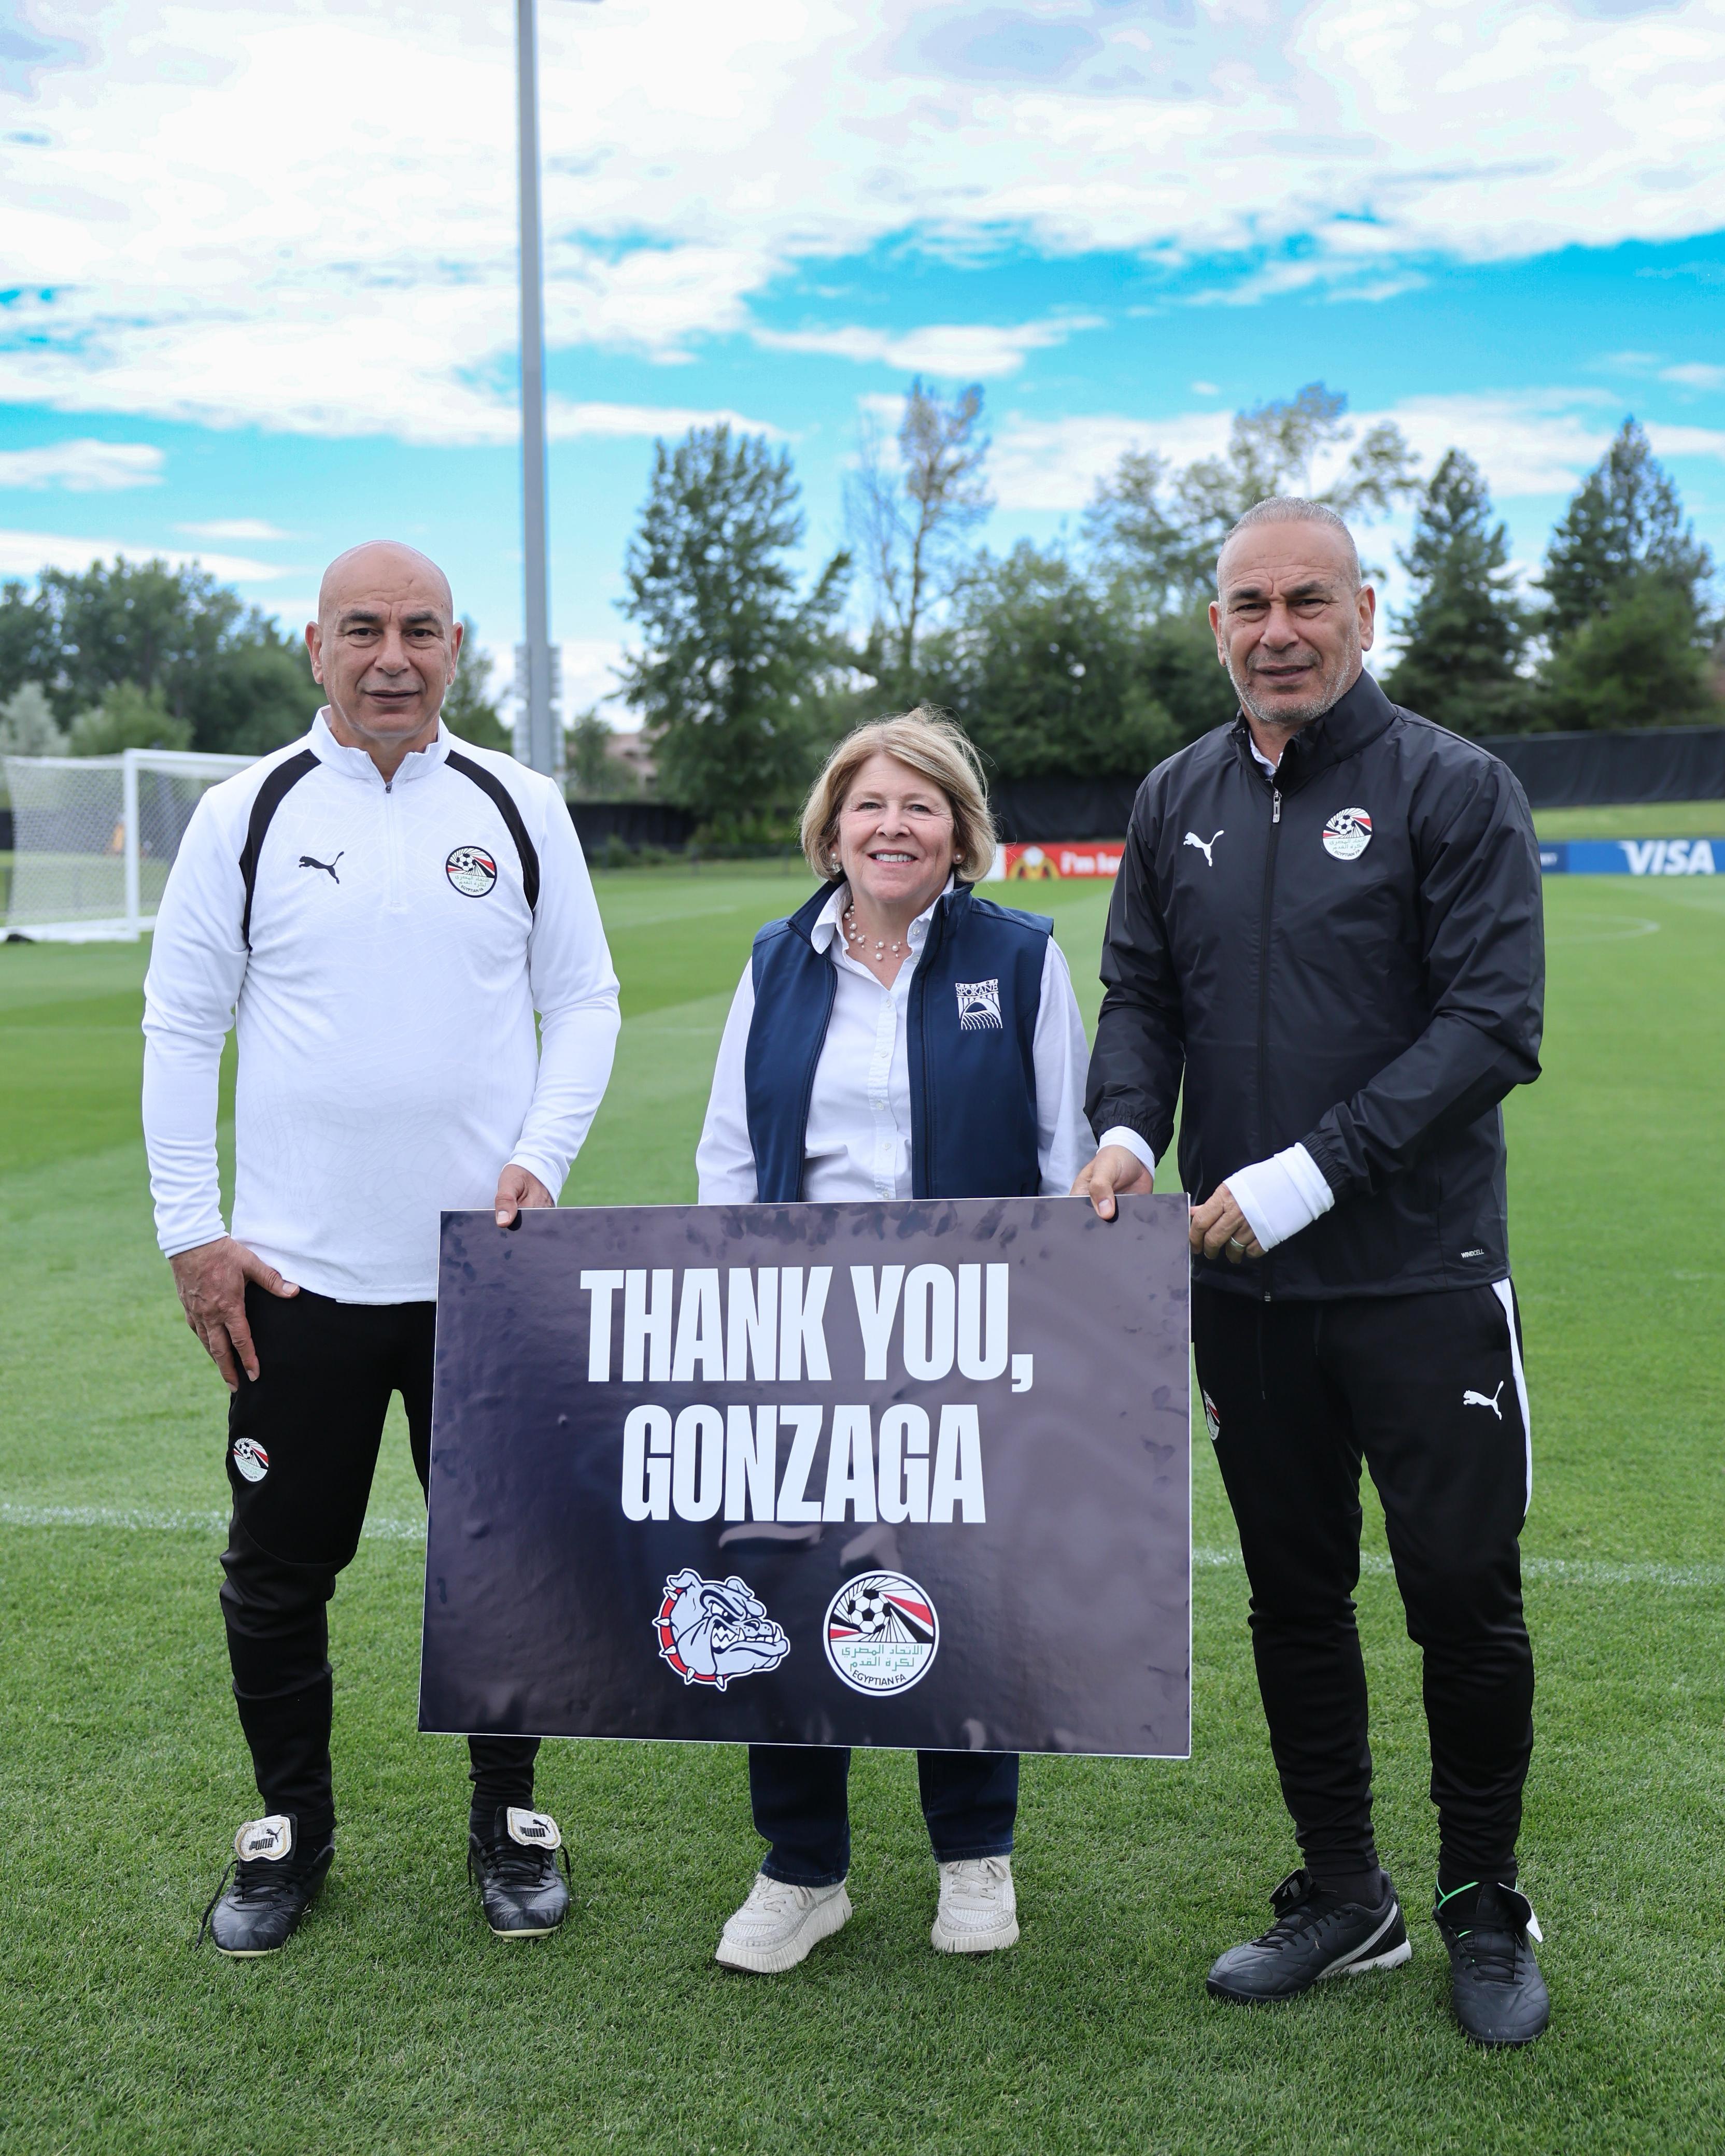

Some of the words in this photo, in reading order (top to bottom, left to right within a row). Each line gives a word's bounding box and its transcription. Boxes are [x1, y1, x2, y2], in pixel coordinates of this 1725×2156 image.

[1619, 840, 1716, 875] VISA
[956, 984, 998, 996] SPOKANE
[1461, 1249, 1484, 1258] WINDCELL
[580, 1266, 833, 1382] THANK
[851, 1263, 1033, 1392] YOU,
[621, 1403, 986, 1524] GONZAGA
[842, 1644, 884, 1658] المصري
[889, 1644, 922, 1655] الاتحاد
[850, 1656, 880, 1671] القدم
[885, 1657, 914, 1671] لكرة
[852, 1670, 894, 1685] EGYPTIAN
[895, 1674, 907, 1683] FA
[519, 1825, 546, 1837] PUMA
[249, 1837, 274, 1850] PUMA
